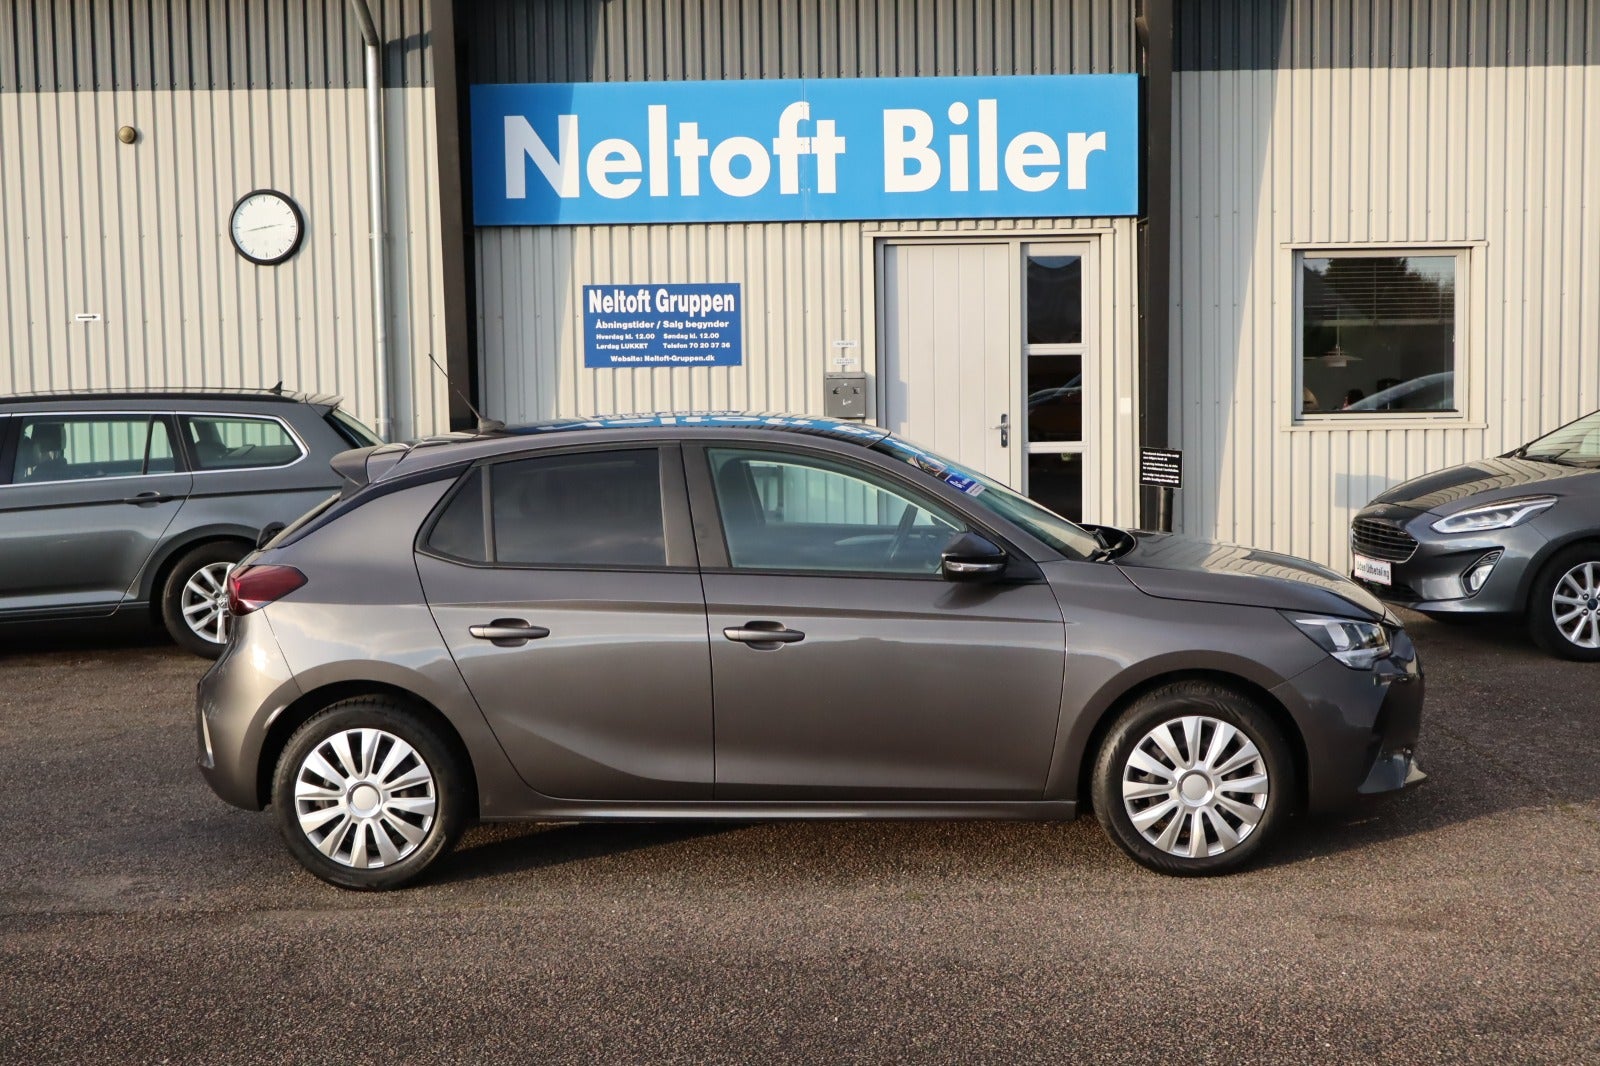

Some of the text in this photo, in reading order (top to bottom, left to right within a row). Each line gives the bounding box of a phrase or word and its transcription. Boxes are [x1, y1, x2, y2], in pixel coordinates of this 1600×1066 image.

[504, 98, 1106, 200] Neltoft Biler
[589, 288, 735, 317] Neltoft Gruppen
[596, 319, 729, 329] Åbningstider / Salg begynder
[644, 355, 715, 363] Neltoft-Gruppen.dk
